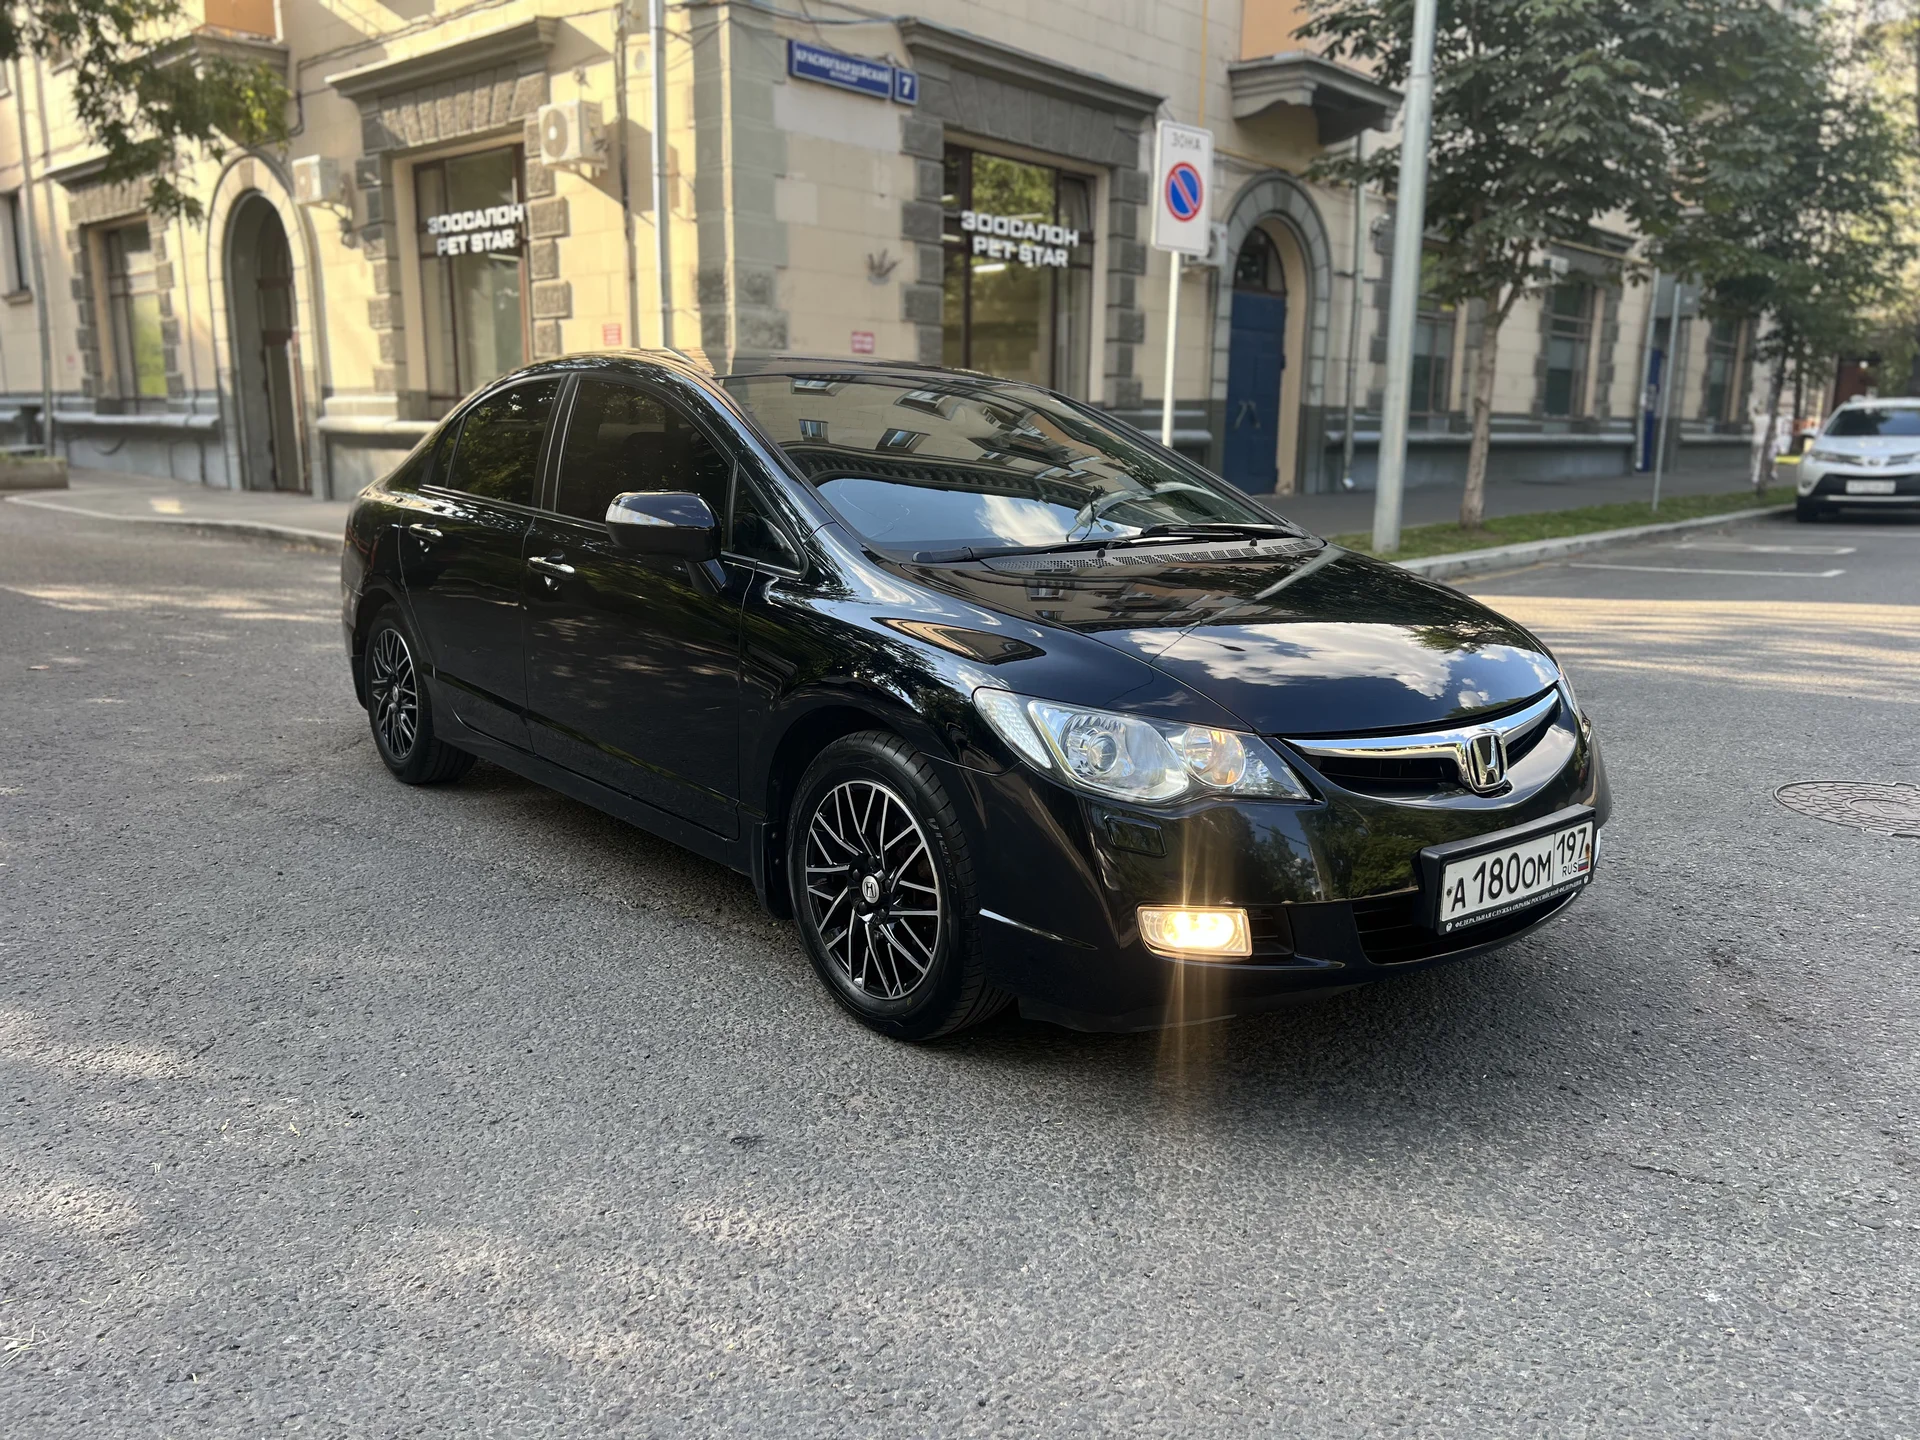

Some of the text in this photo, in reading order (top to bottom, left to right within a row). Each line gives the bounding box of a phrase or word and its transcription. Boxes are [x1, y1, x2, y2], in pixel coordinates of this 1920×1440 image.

[901, 76, 913, 96] 7
[1171, 132, 1202, 152] ЗОНА
[427, 203, 524, 235] ЗООСАЛОН
[960, 210, 1079, 247] ЗООСАЛОН
[437, 228, 515, 256] PET STAR
[972, 235, 1069, 268] PET STAR
[1557, 827, 1587, 865] 197
[1562, 861, 1578, 877] RUS
